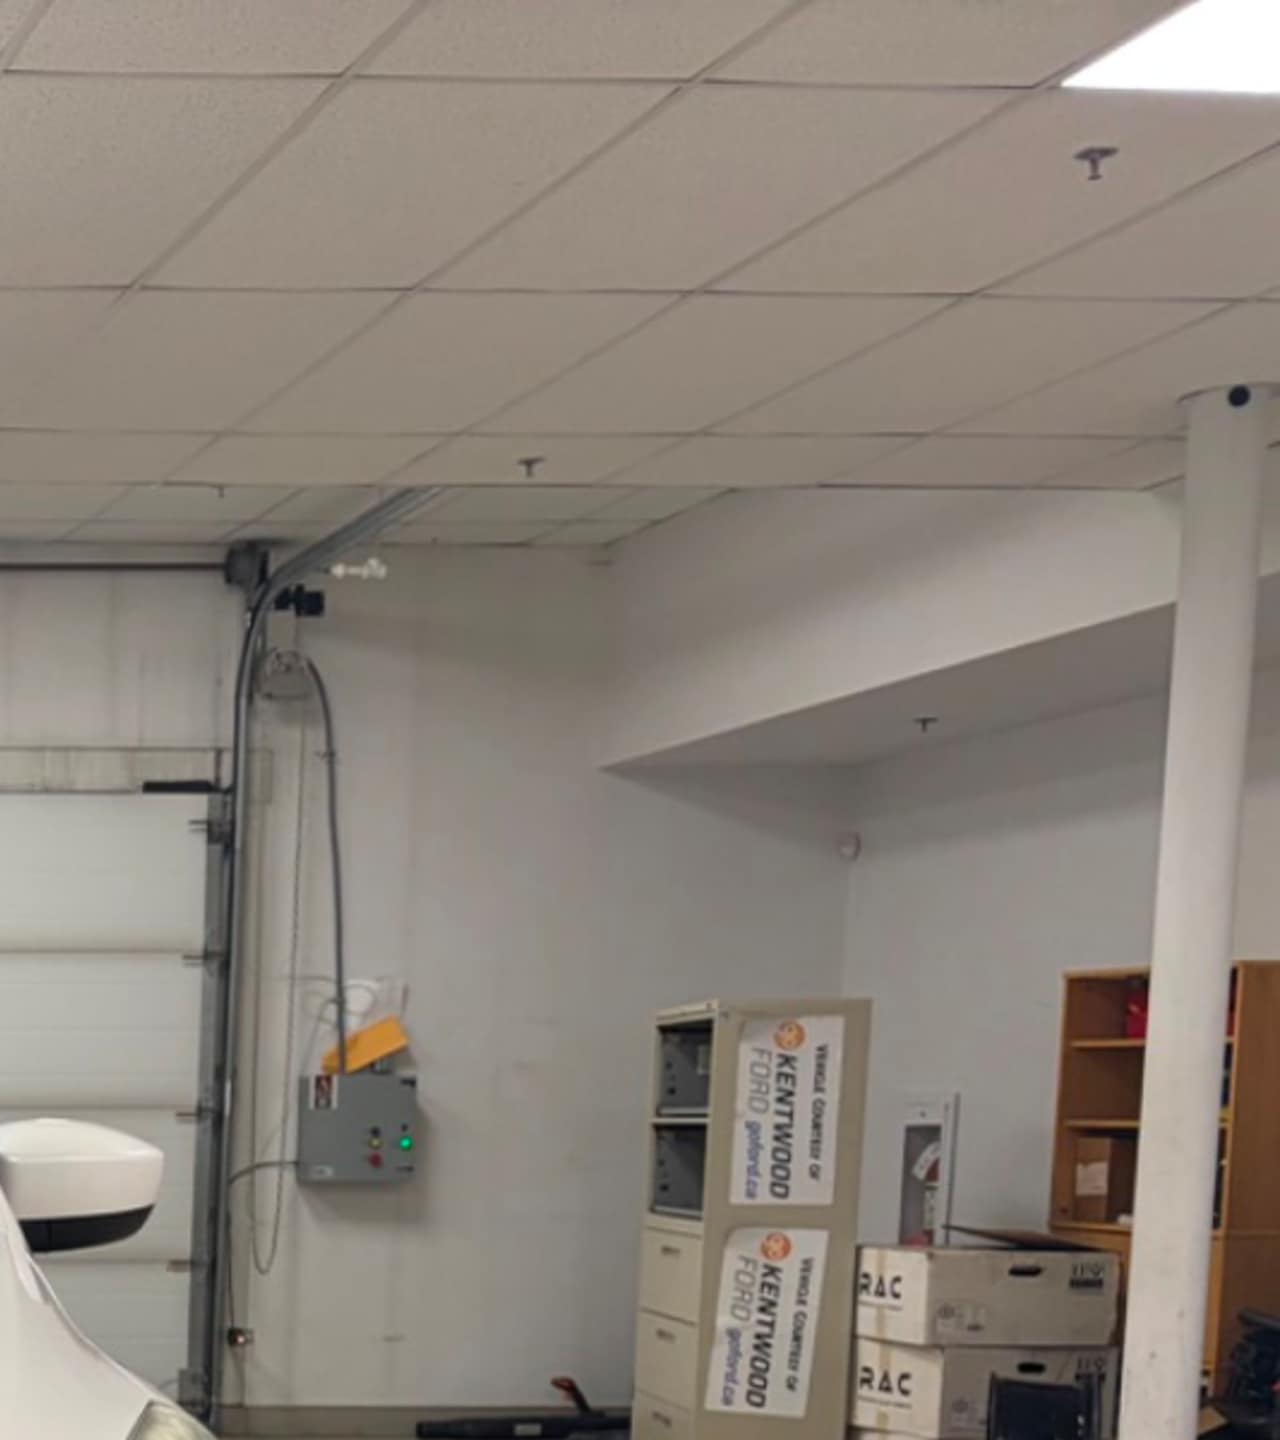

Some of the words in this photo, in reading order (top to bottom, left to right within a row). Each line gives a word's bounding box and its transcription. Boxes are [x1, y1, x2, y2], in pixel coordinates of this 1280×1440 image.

[747, 1047, 772, 1115] FORD
[770, 1053, 797, 1199] KENTWOOD
[730, 1255, 760, 1322] FORD
[745, 1263, 784, 1409] KENTWOOD
